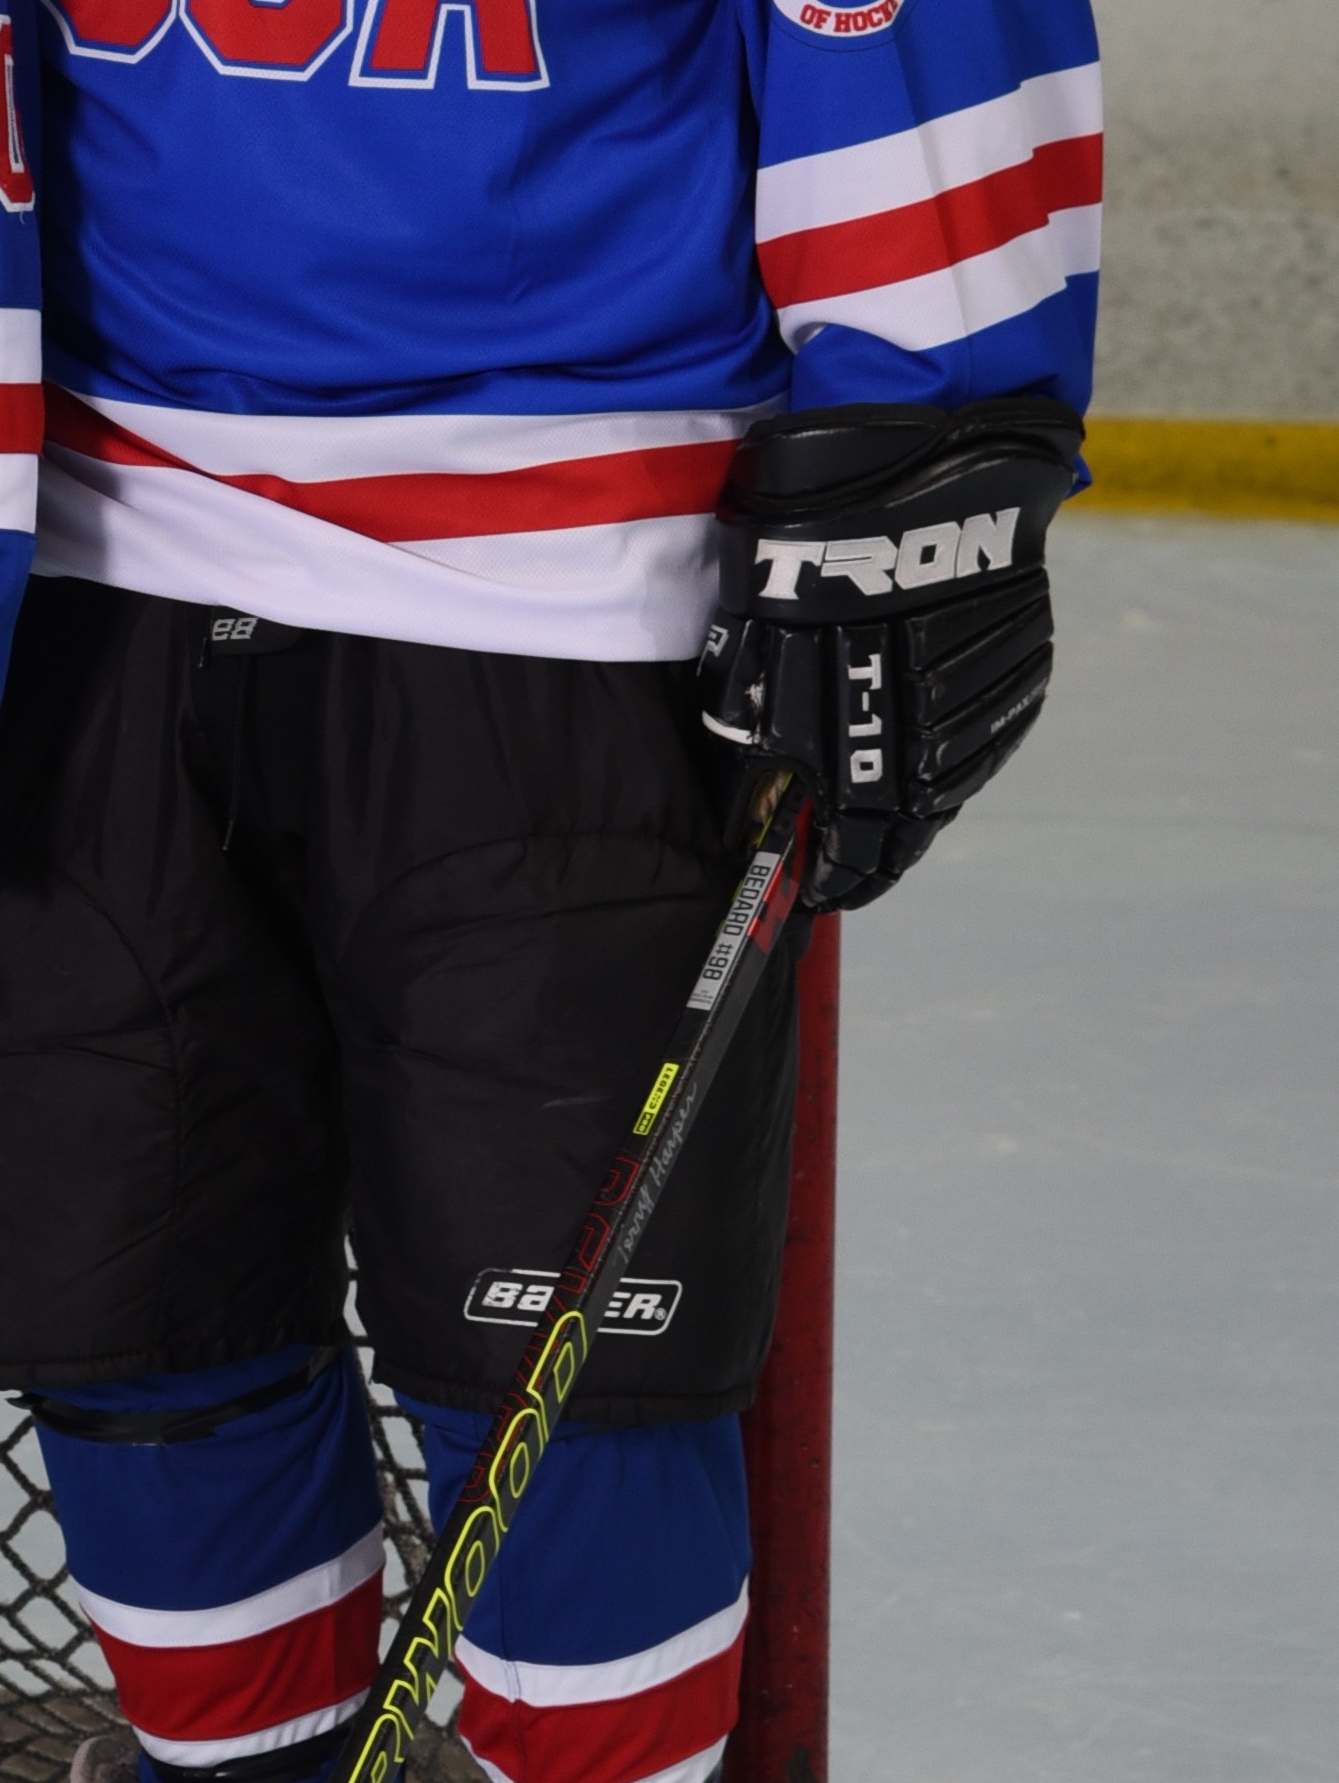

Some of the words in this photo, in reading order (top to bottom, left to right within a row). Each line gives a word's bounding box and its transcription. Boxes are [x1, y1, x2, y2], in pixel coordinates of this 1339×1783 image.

[799, 4, 831, 30] OF
[753, 507, 1021, 600] TRON
[847, 653, 883, 784] T-10
[723, 863, 771, 938] BEDARD
[702, 941, 735, 982] #98
[481, 1281, 662, 1320] BAER
